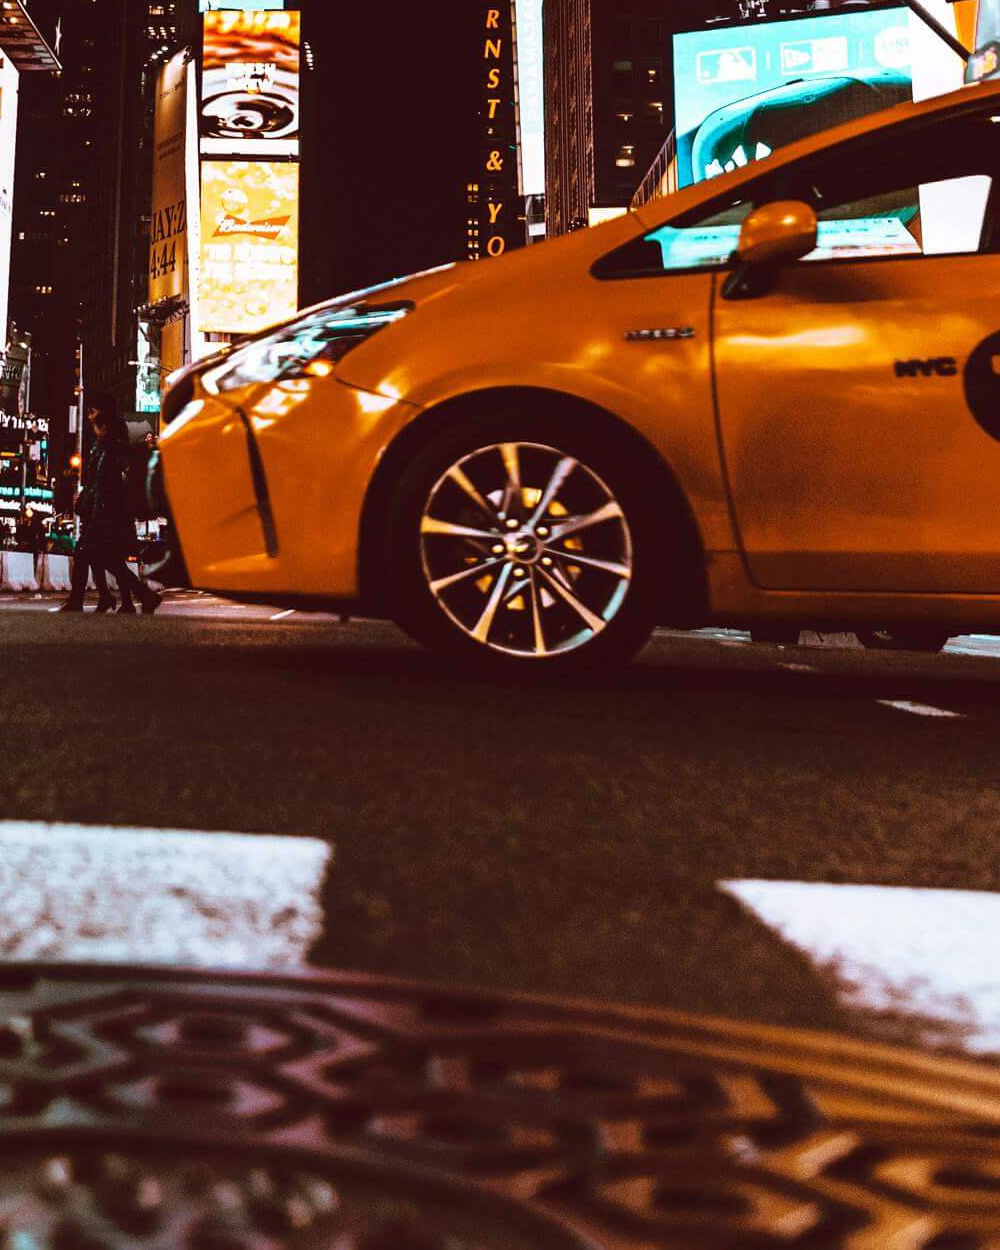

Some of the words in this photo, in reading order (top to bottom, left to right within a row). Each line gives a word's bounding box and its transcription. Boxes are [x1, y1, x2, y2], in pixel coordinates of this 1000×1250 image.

[486, 151, 503, 171] &
[150, 240, 176, 280] 4:44
[895, 357, 957, 378] NYC
